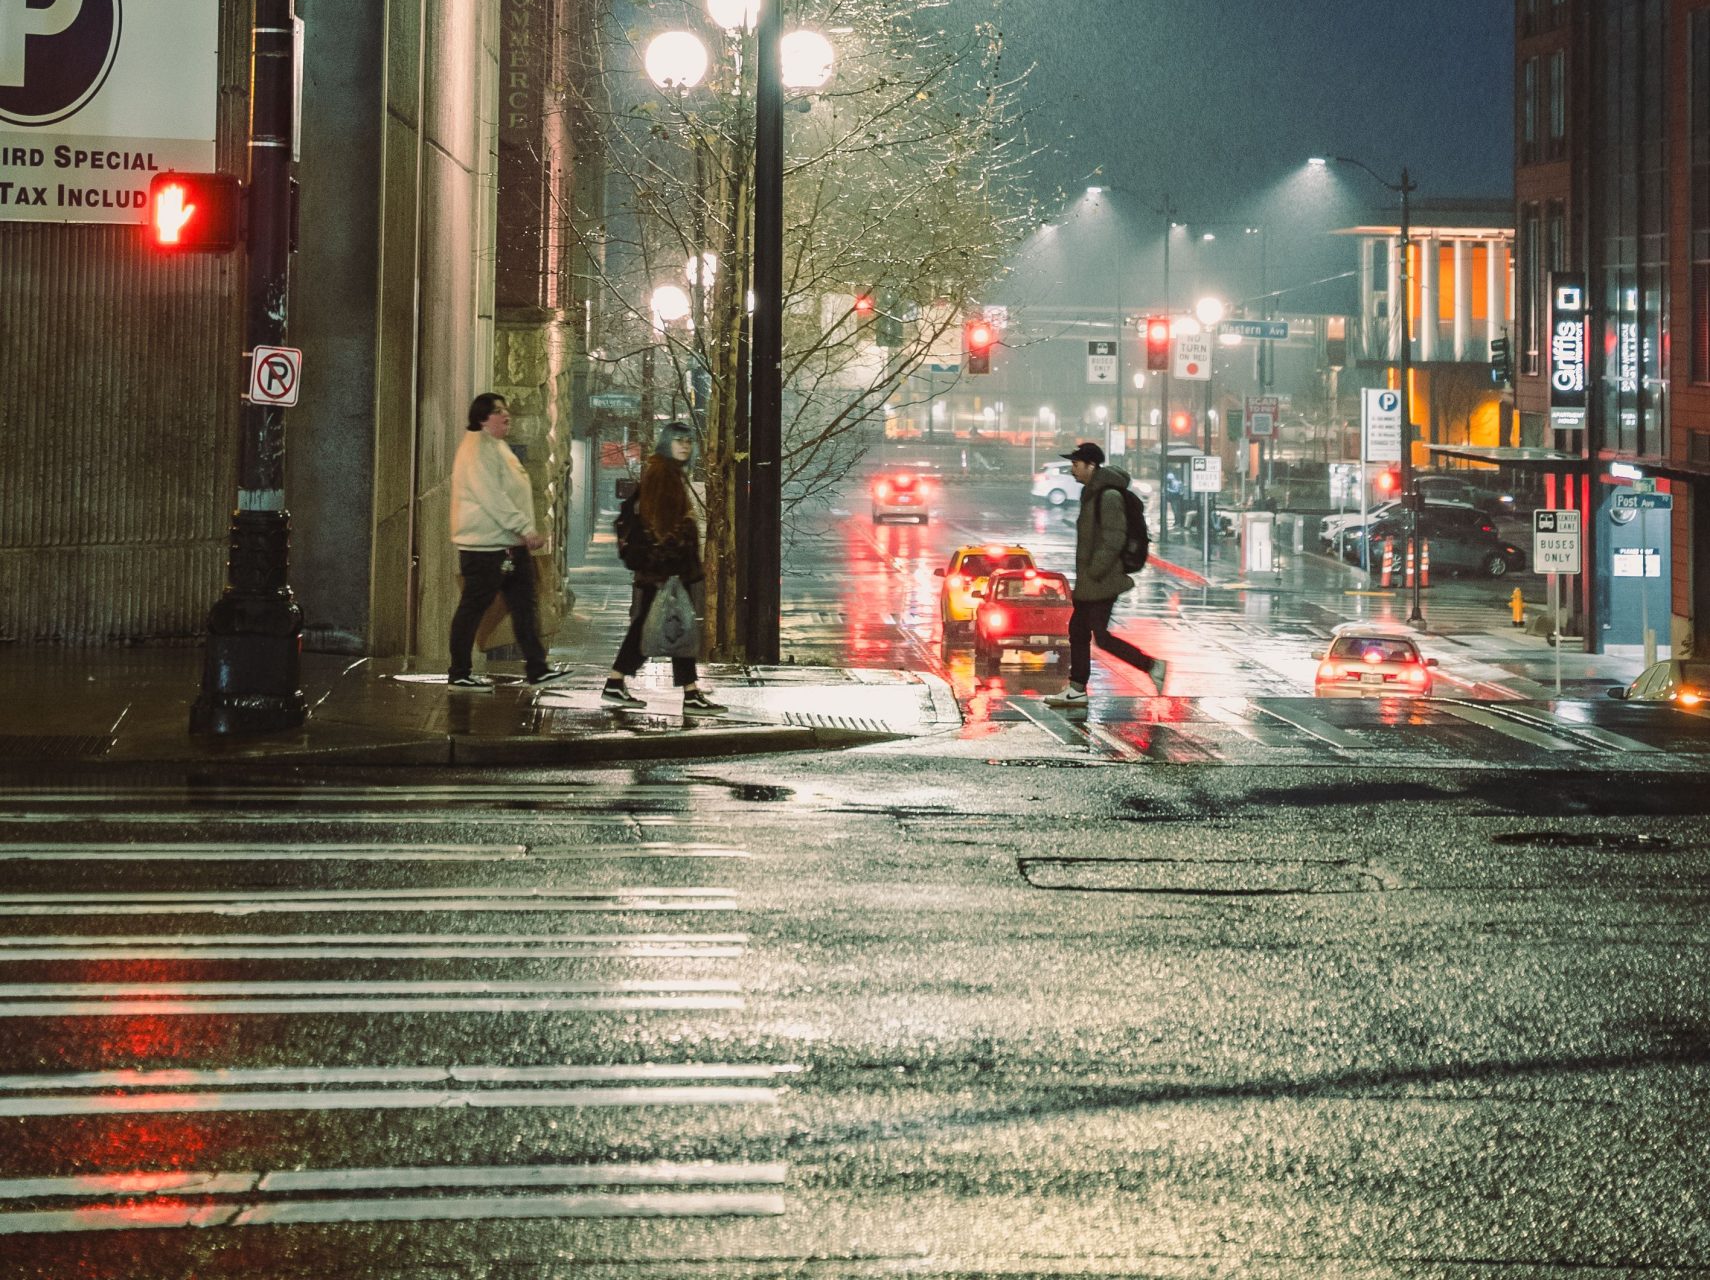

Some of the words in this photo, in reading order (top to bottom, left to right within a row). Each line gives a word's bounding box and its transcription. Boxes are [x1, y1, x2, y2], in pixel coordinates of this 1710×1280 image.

[54, 145, 159, 171] SPECIAL
[0, 182, 48, 207] TAX
[57, 184, 148, 209] INCLUD
[1268, 325, 1286, 336] Ave
[1181, 343, 1207, 353] TURN
[1179, 353, 1190, 361] ON
[1193, 353, 1208, 362] RED
[1552, 321, 1577, 391] Griffis
[1617, 495, 1638, 508] Post
[1641, 499, 1656, 508] Ave
[1540, 540, 1575, 549] BUSES
[1544, 553, 1571, 563] ONLY
